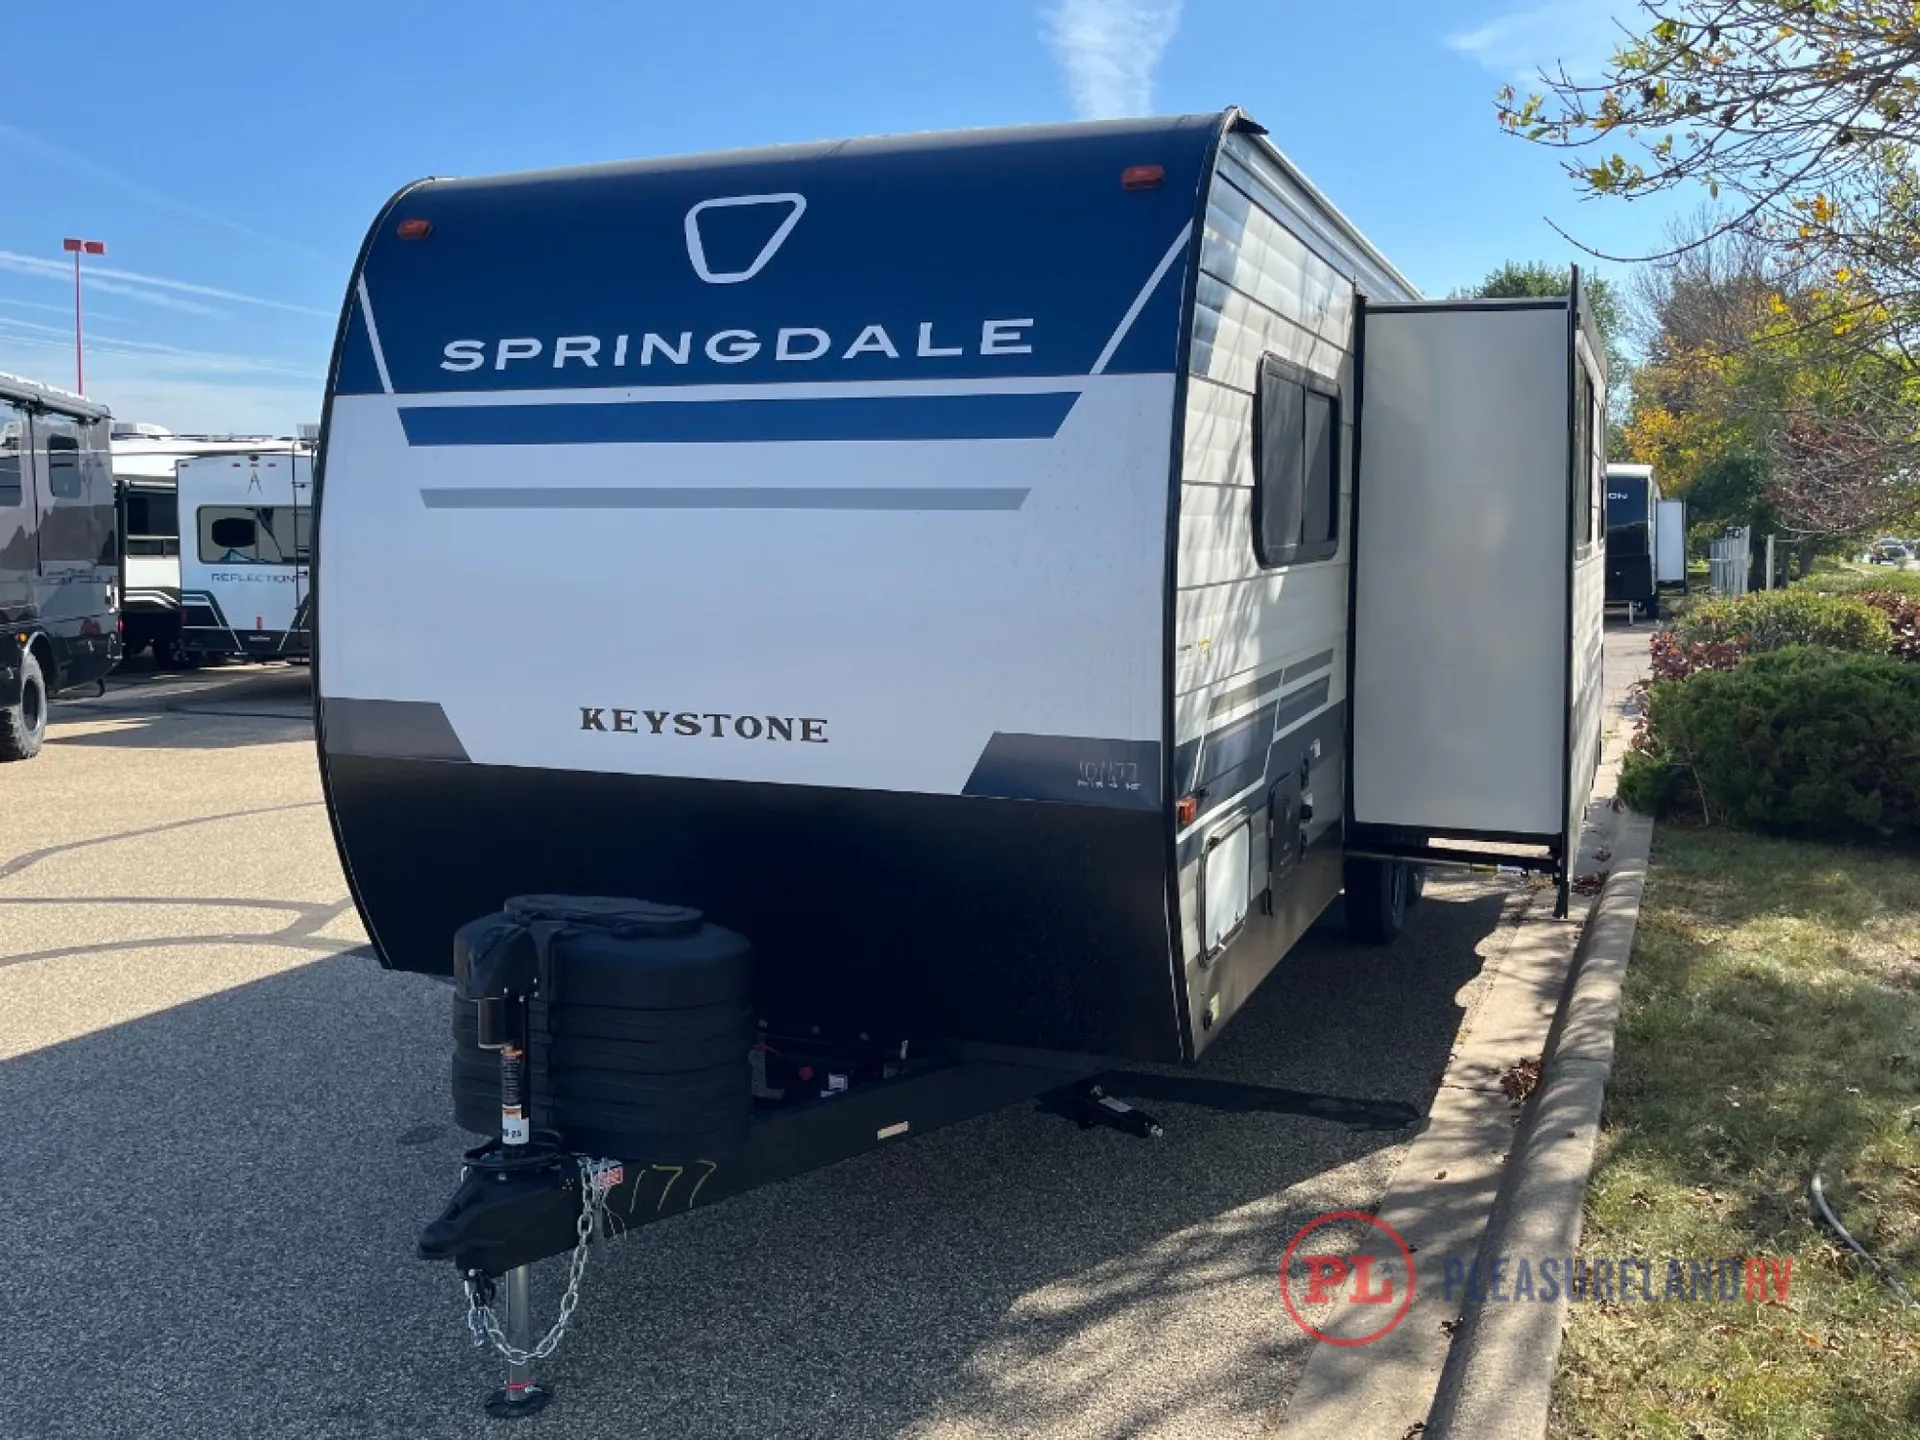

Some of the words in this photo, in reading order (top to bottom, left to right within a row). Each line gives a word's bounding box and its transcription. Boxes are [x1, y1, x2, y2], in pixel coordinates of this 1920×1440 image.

[440, 317, 1035, 373] SPRINGDALE
[210, 572, 297, 584] REFLECTION
[579, 706, 829, 743] KEYSTONE
